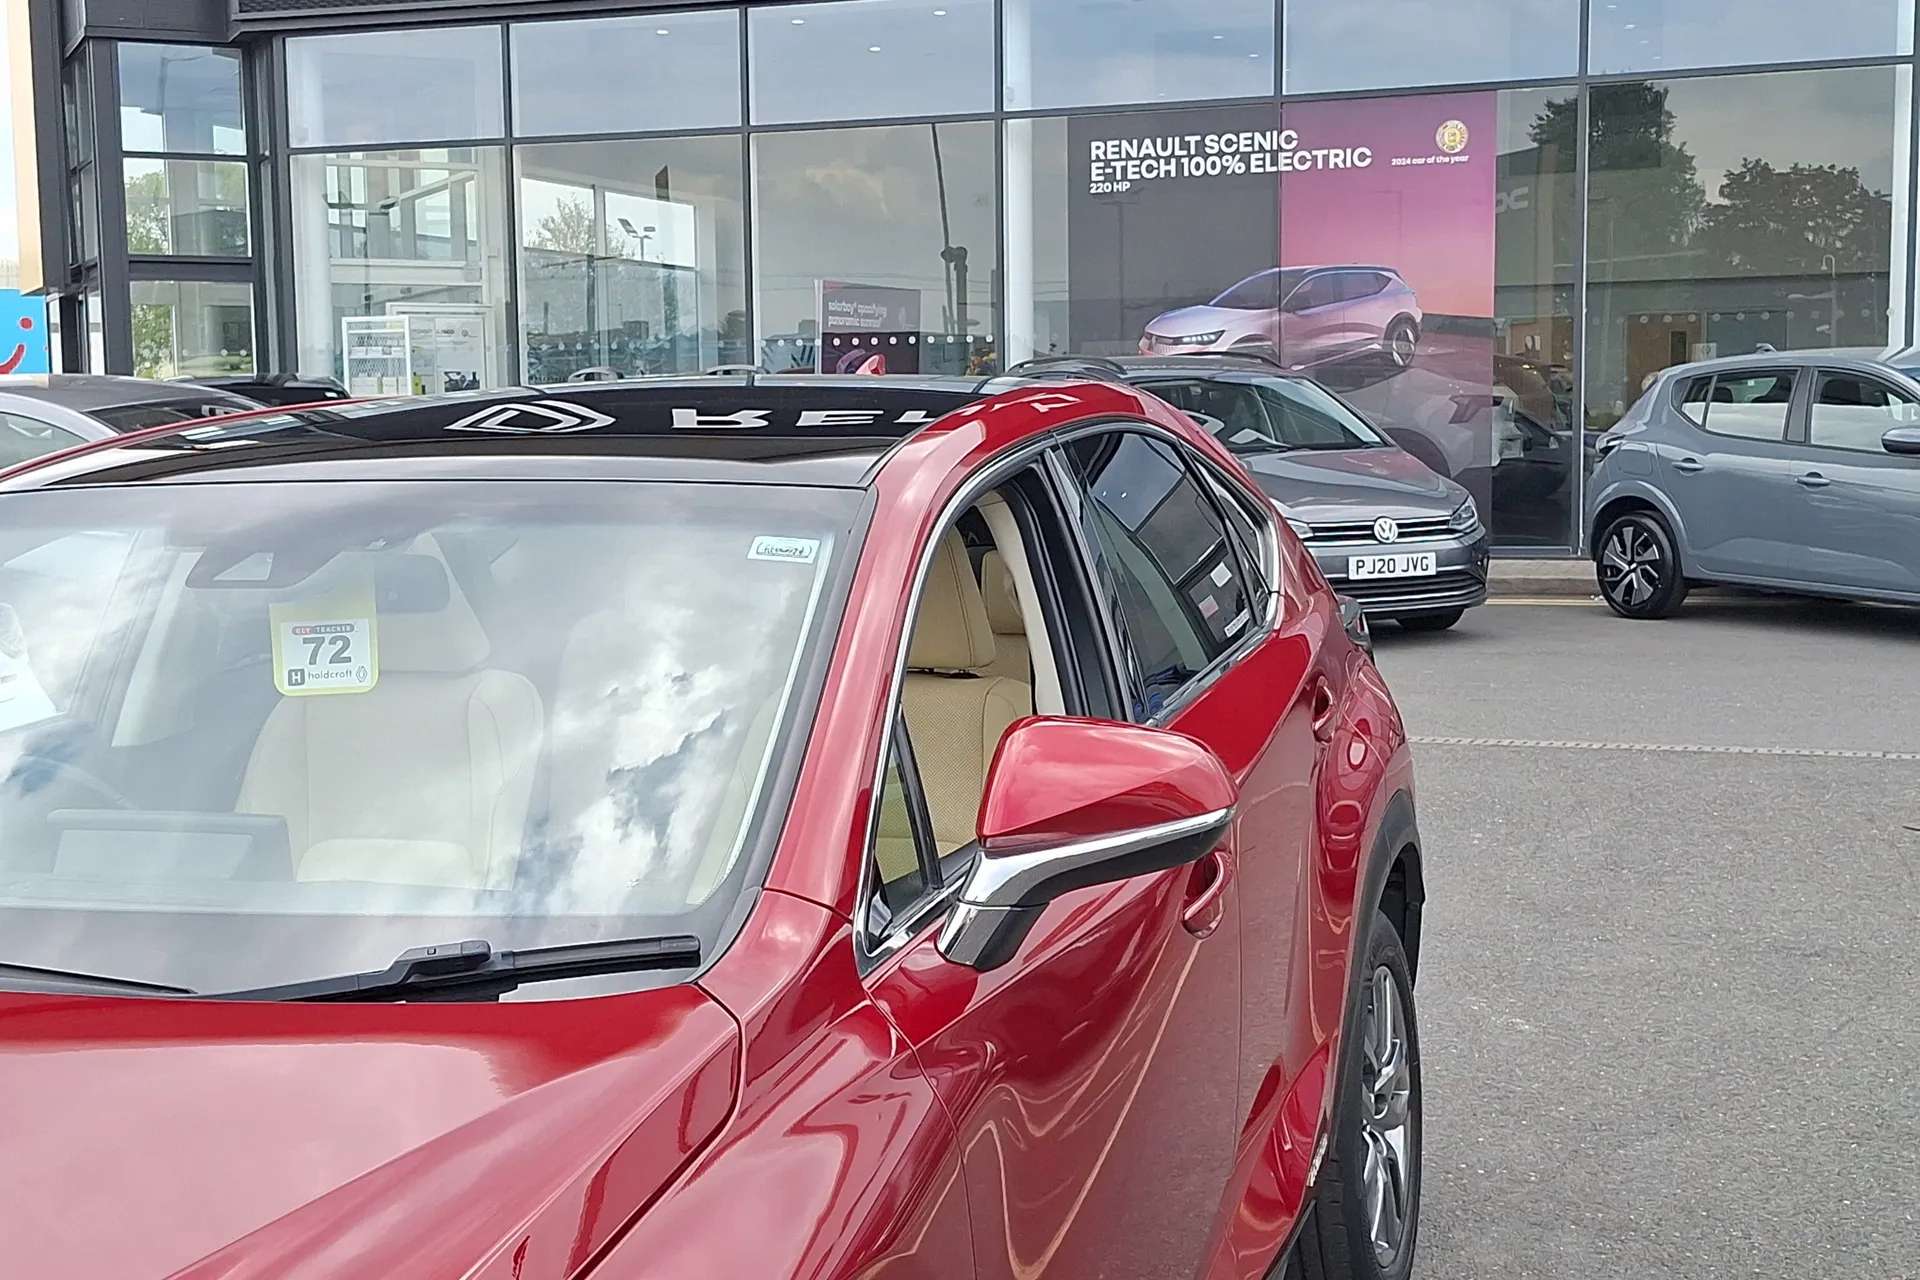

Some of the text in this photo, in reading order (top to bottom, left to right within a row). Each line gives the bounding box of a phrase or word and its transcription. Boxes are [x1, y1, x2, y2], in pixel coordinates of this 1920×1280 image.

[1090, 130, 1298, 161] RENAULT SCENIC
[1091, 147, 1372, 181] E-TECH 100% ELECTRIC
[1391, 157, 1411, 166] 2024
[1426, 155, 1435, 164] of
[1436, 155, 1450, 164] the
[1450, 155, 1469, 164] year
[1089, 181, 1131, 194] 220 HP
[1356, 556, 1429, 575] PJ20 JVG
[302, 635, 352, 665] 72
[308, 669, 352, 681] holdcroft
